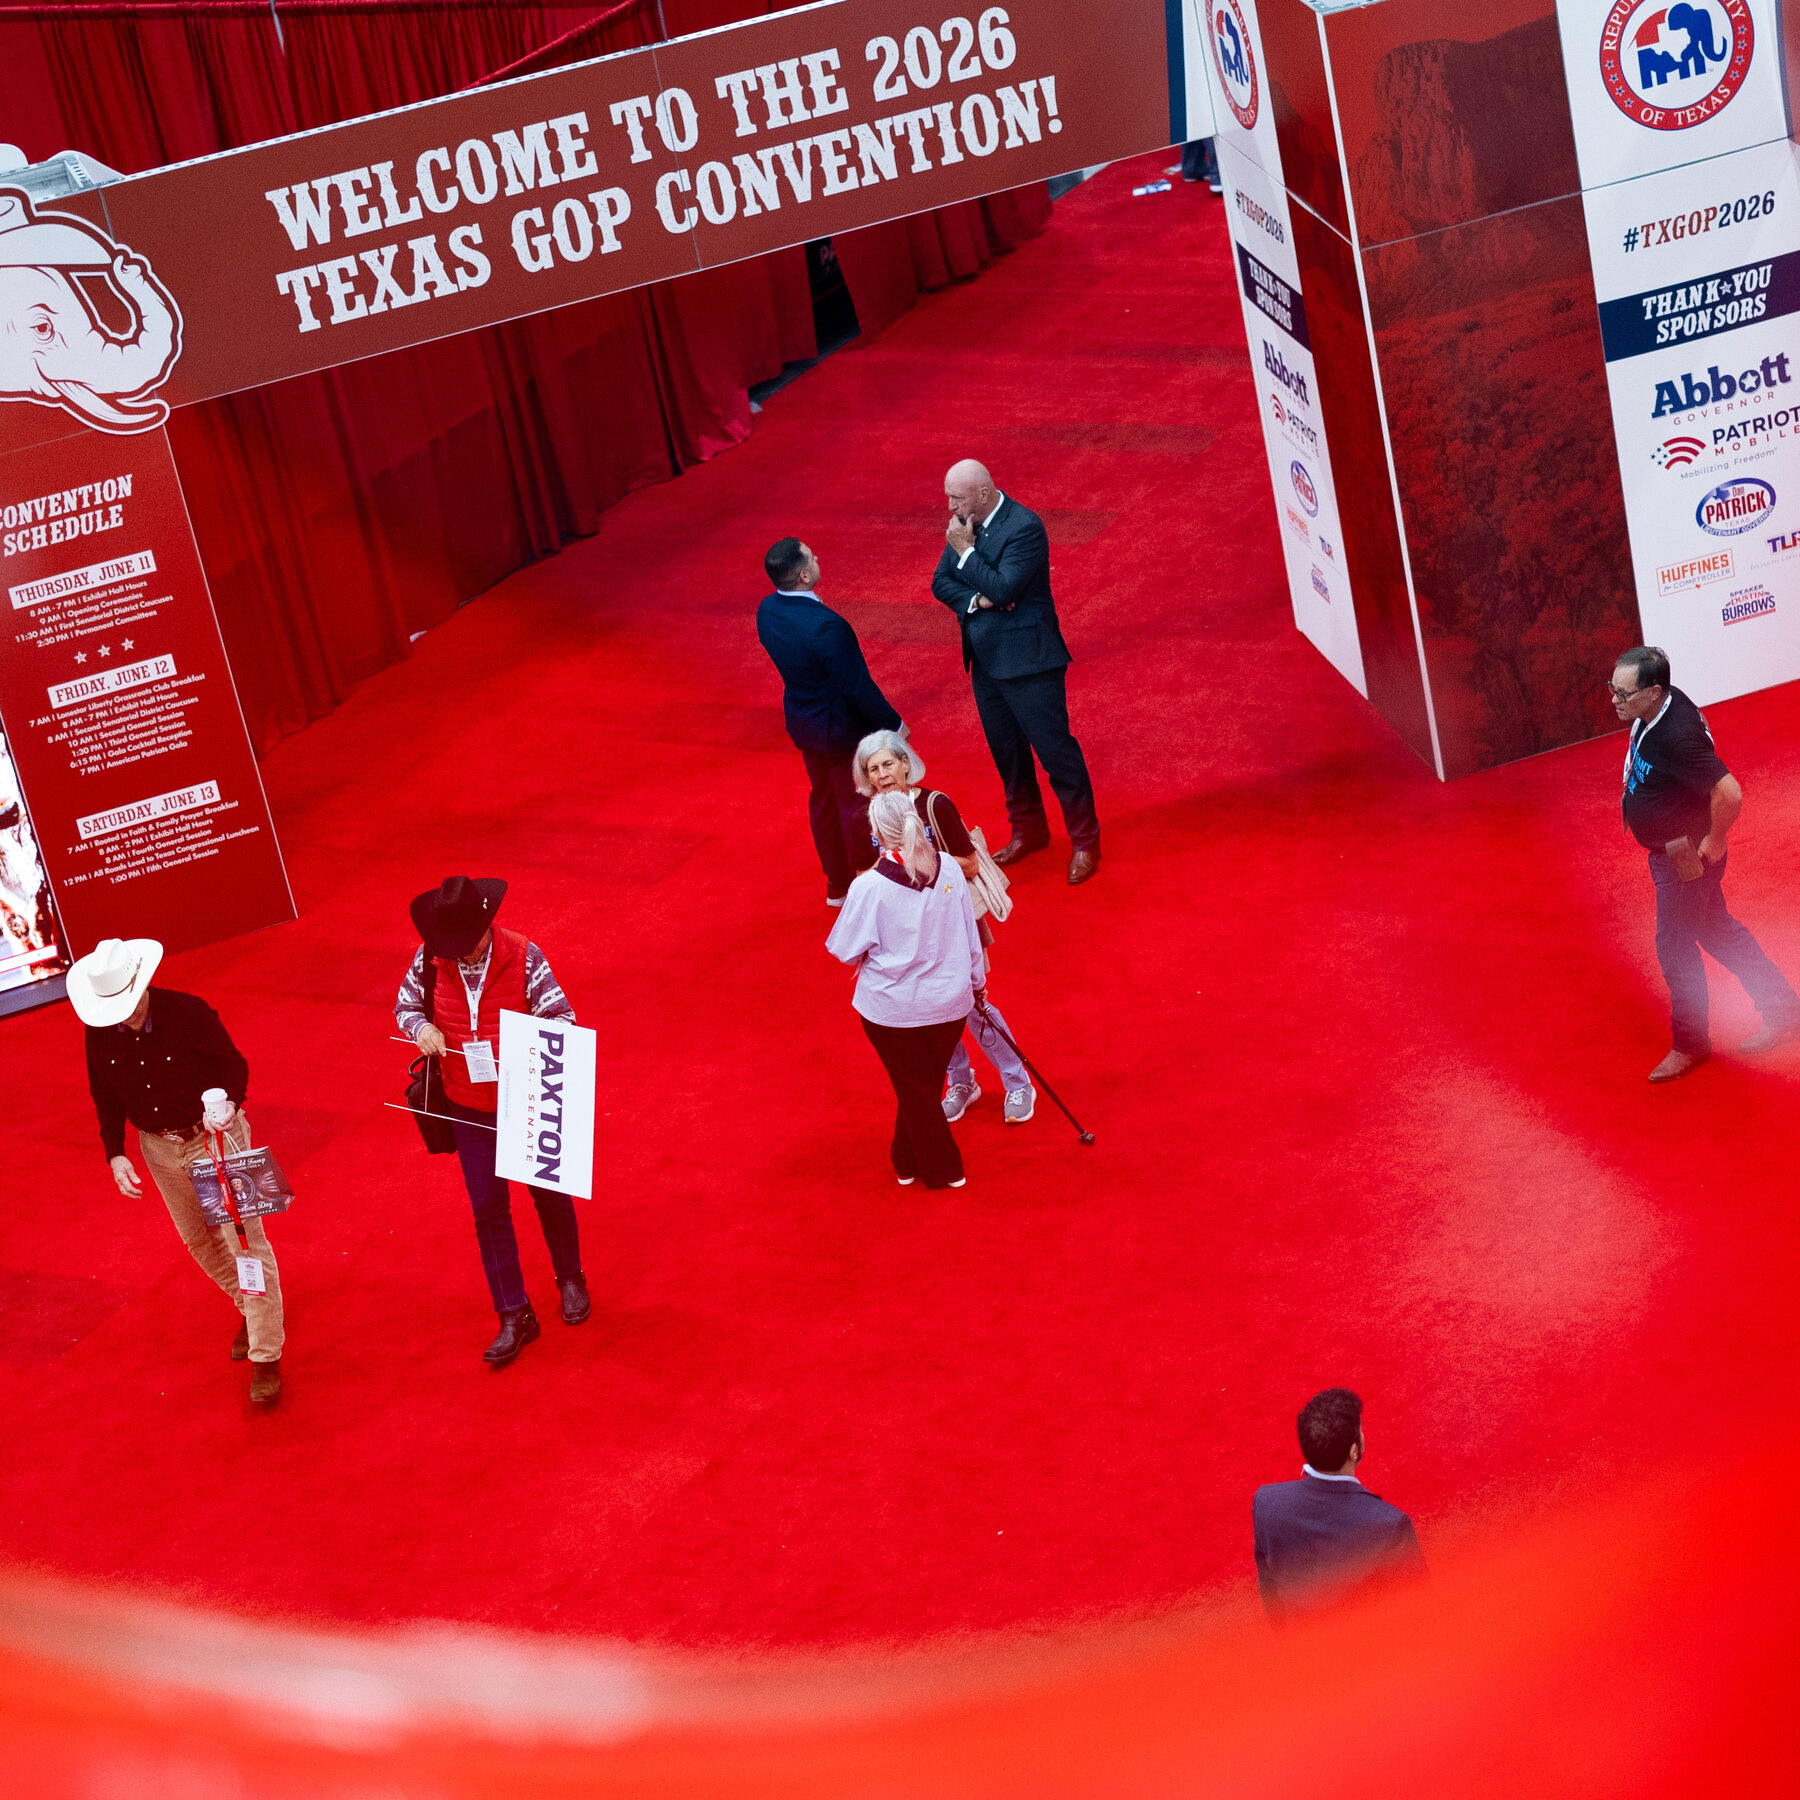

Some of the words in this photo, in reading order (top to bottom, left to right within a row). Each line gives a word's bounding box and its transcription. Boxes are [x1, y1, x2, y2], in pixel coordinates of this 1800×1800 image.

[1641, 107, 1665, 125] OF
[1674, 84, 1731, 126] TEXAS
[265, 111, 599, 251] WELCOME
[609, 87, 698, 164] TO
[714, 47, 849, 137] THE
[865, 6, 1017, 102] 2026
[275, 223, 491, 333] TEXAS
[511, 187, 631, 273] GOP
[655, 75, 1062, 234] CONVENTION!
[1623, 190, 1775, 253] #TXGOP2026
[1642, 279, 1720, 321] THANK
[1732, 264, 1773, 297] YOU
[1656, 293, 1767, 344] SPONSORS
[1263, 338, 1310, 407] Abbott
[1651, 352, 1791, 419] Abbott
[1673, 391, 1775, 425] GOVERNOR
[1712, 406, 1800, 445] PATRIOT
[1715, 425, 1800, 456] MOBILE
[1680, 462, 1729, 480] Mobilizing
[1705, 490, 1767, 525] PATRICK
[1732, 486, 1745, 497] Dan
[3, 504, 124, 557] SCHEDULE
[1725, 517, 1751, 528] TEXAS
[15, 571, 95, 604] THURSDAY,
[99, 560, 135, 582] JUNE
[140, 555, 151, 570] 11
[1661, 554, 1729, 584] HUFFINES
[1673, 568, 1731, 589] COMPTROLLER
[37, 605, 51, 615] AM
[63, 598, 76, 607] PM
[82, 590, 107, 602] Exhibit
[108, 585, 124, 595] Hall
[124, 581, 147, 590] Hours
[47, 613, 61, 622] AM
[66, 604, 99, 617] Opening
[100, 592, 142, 608] Ceremonies
[1722, 595, 1776, 622] BURROWS
[1730, 584, 1763, 597] SPEAKER
[1730, 591, 1764, 606] DUSTIN
[15, 630, 38, 642] 11:30
[39, 626, 53, 635] AM
[58, 621, 74, 630] First
[75, 609, 112, 625] Senatorial
[113, 603, 138, 615] District
[139, 595, 173, 607] Caucuses
[36, 636, 54, 647] 2:30
[55, 632, 68, 641] PM
[74, 620, 113, 636] Permanent
[114, 610, 156, 625] Committees
[37, 716, 50, 725] AM
[56, 706, 86, 719] Lonestar
[87, 699, 112, 710] Liberty
[113, 688, 152, 702] Grassroots
[152, 682, 170, 692] Club
[170, 673, 204, 687] Breakfast
[55, 678, 111, 703] FRIDAY,
[114, 665, 150, 687] JUNE
[154, 660, 170, 675] 12
[54, 732, 68, 741] AM
[74, 722, 101, 735] Second
[101, 711, 138, 727] Senatorial
[139, 705, 164, 716] District
[165, 696, 198, 709] Caucuses
[69, 717, 83, 726] AM
[95, 710, 108, 718] PM
[114, 701, 138, 713] Exhibit
[139, 696, 155, 706] Hall
[156, 692, 178, 701] Hours
[68, 739, 78, 747] 10
[80, 735, 93, 744] AM
[99, 725, 125, 738] Second
[126, 716, 156, 730] General
[157, 711, 184, 722] Session
[71, 746, 89, 756] 1:30
[90, 743, 102, 751] PM
[108, 735, 127, 746] Third
[128, 726, 158, 740] General
[158, 721, 185, 732] Session
[70, 757, 87, 768] 6:15
[88, 754, 101, 762] PM
[107, 747, 126, 756] Gala
[126, 737, 156, 751] Cocktail
[156, 729, 192, 742] Reception
[87, 764, 100, 773] PM
[106, 754, 140, 768] American
[140, 746, 168, 757] Patriots
[168, 740, 187, 750] Gala
[75, 843, 88, 852] AM
[94, 833, 119, 846] Rooted
[128, 826, 146, 836] Faith
[155, 817, 178, 828] Family
[179, 811, 203, 821] Prayer
[204, 800, 238, 814] Breakfast
[82, 803, 157, 834] SATURDAY,
[161, 791, 196, 812] JUNE
[200, 785, 215, 801] 13
[74, 874, 87, 882] PM
[94, 868, 103, 877] All
[104, 863, 126, 874] Roads
[127, 856, 145, 867] Lead
[154, 850, 175, 859] Texas
[176, 833, 225, 853] Congressional
[226, 826, 259, 839] Luncheon
[106, 844, 119, 853] AM
[131, 837, 144, 845] PM
[149, 828, 174, 840] Exhibit
[175, 823, 190, 832] Hall
[191, 818, 212, 828] Hours
[112, 852, 126, 861] AM
[131, 844, 154, 855] Fourth
[155, 835, 184, 848] General
[185, 829, 211, 840] Session
[110, 873, 127, 883] 1:00
[127, 869, 140, 878] PM
[146, 863, 161, 872] Fifth
[162, 854, 191, 867] General
[192, 848, 218, 859] Session
[528, 1047, 536, 1082] U.S.
[534, 1029, 565, 1184] PAXTON
[526, 1094, 535, 1162] SENATE
